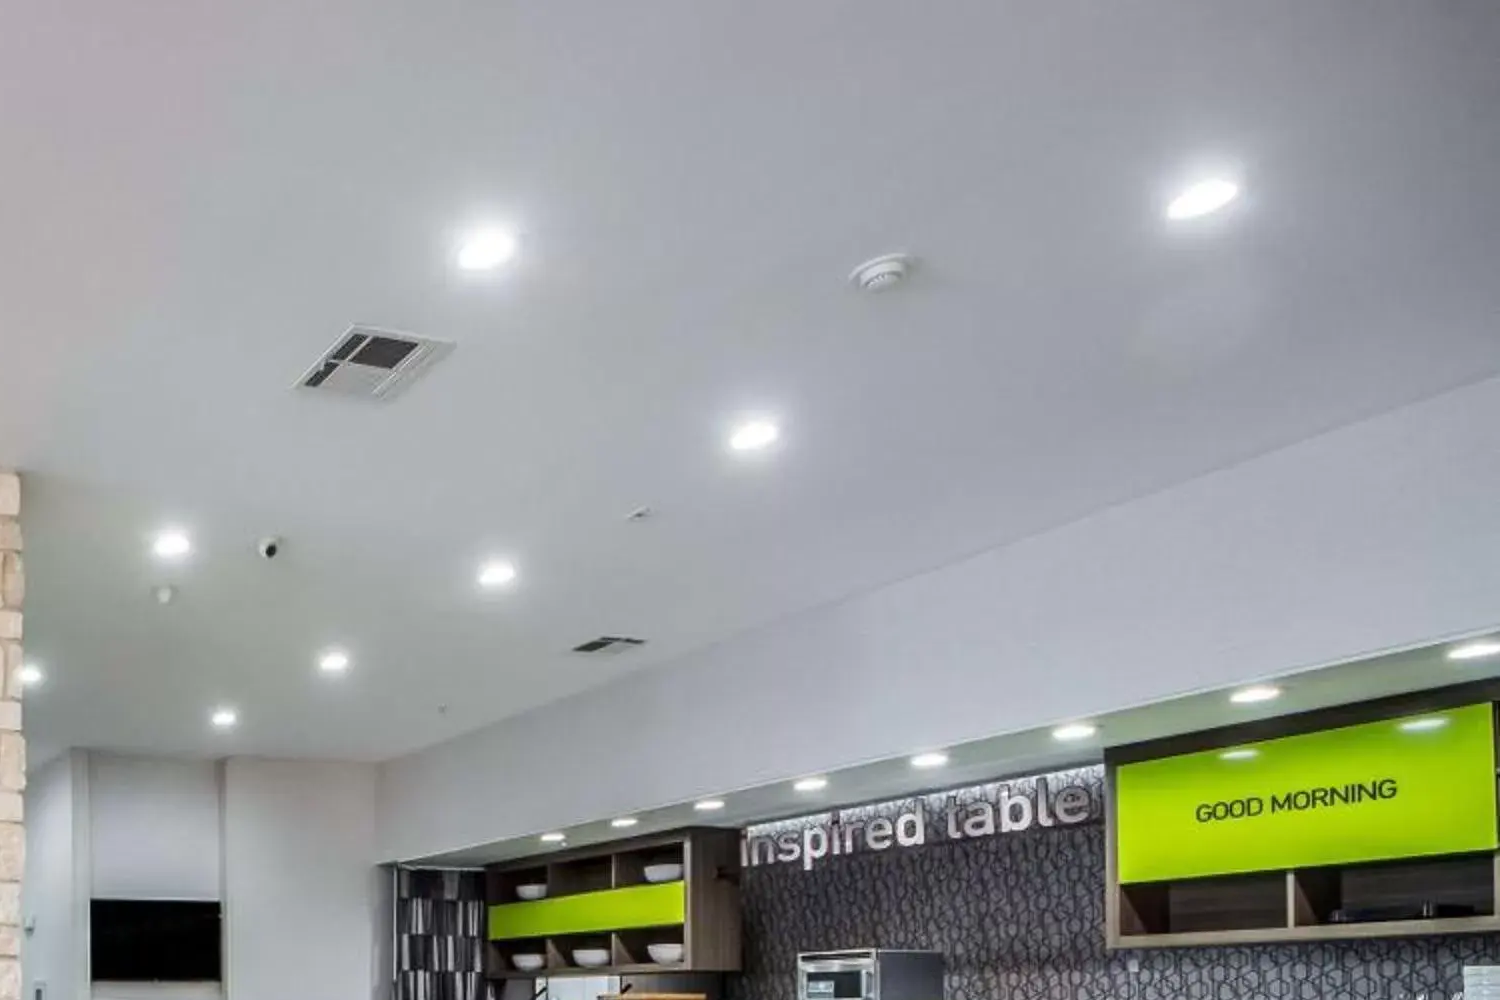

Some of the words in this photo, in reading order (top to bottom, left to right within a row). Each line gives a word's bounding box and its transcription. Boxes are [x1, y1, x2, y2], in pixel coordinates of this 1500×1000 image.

[740, 796, 926, 871] inspired
[946, 776, 1093, 840] table
[1195, 796, 1264, 823] GOOD
[1270, 778, 1398, 815] MORNING
